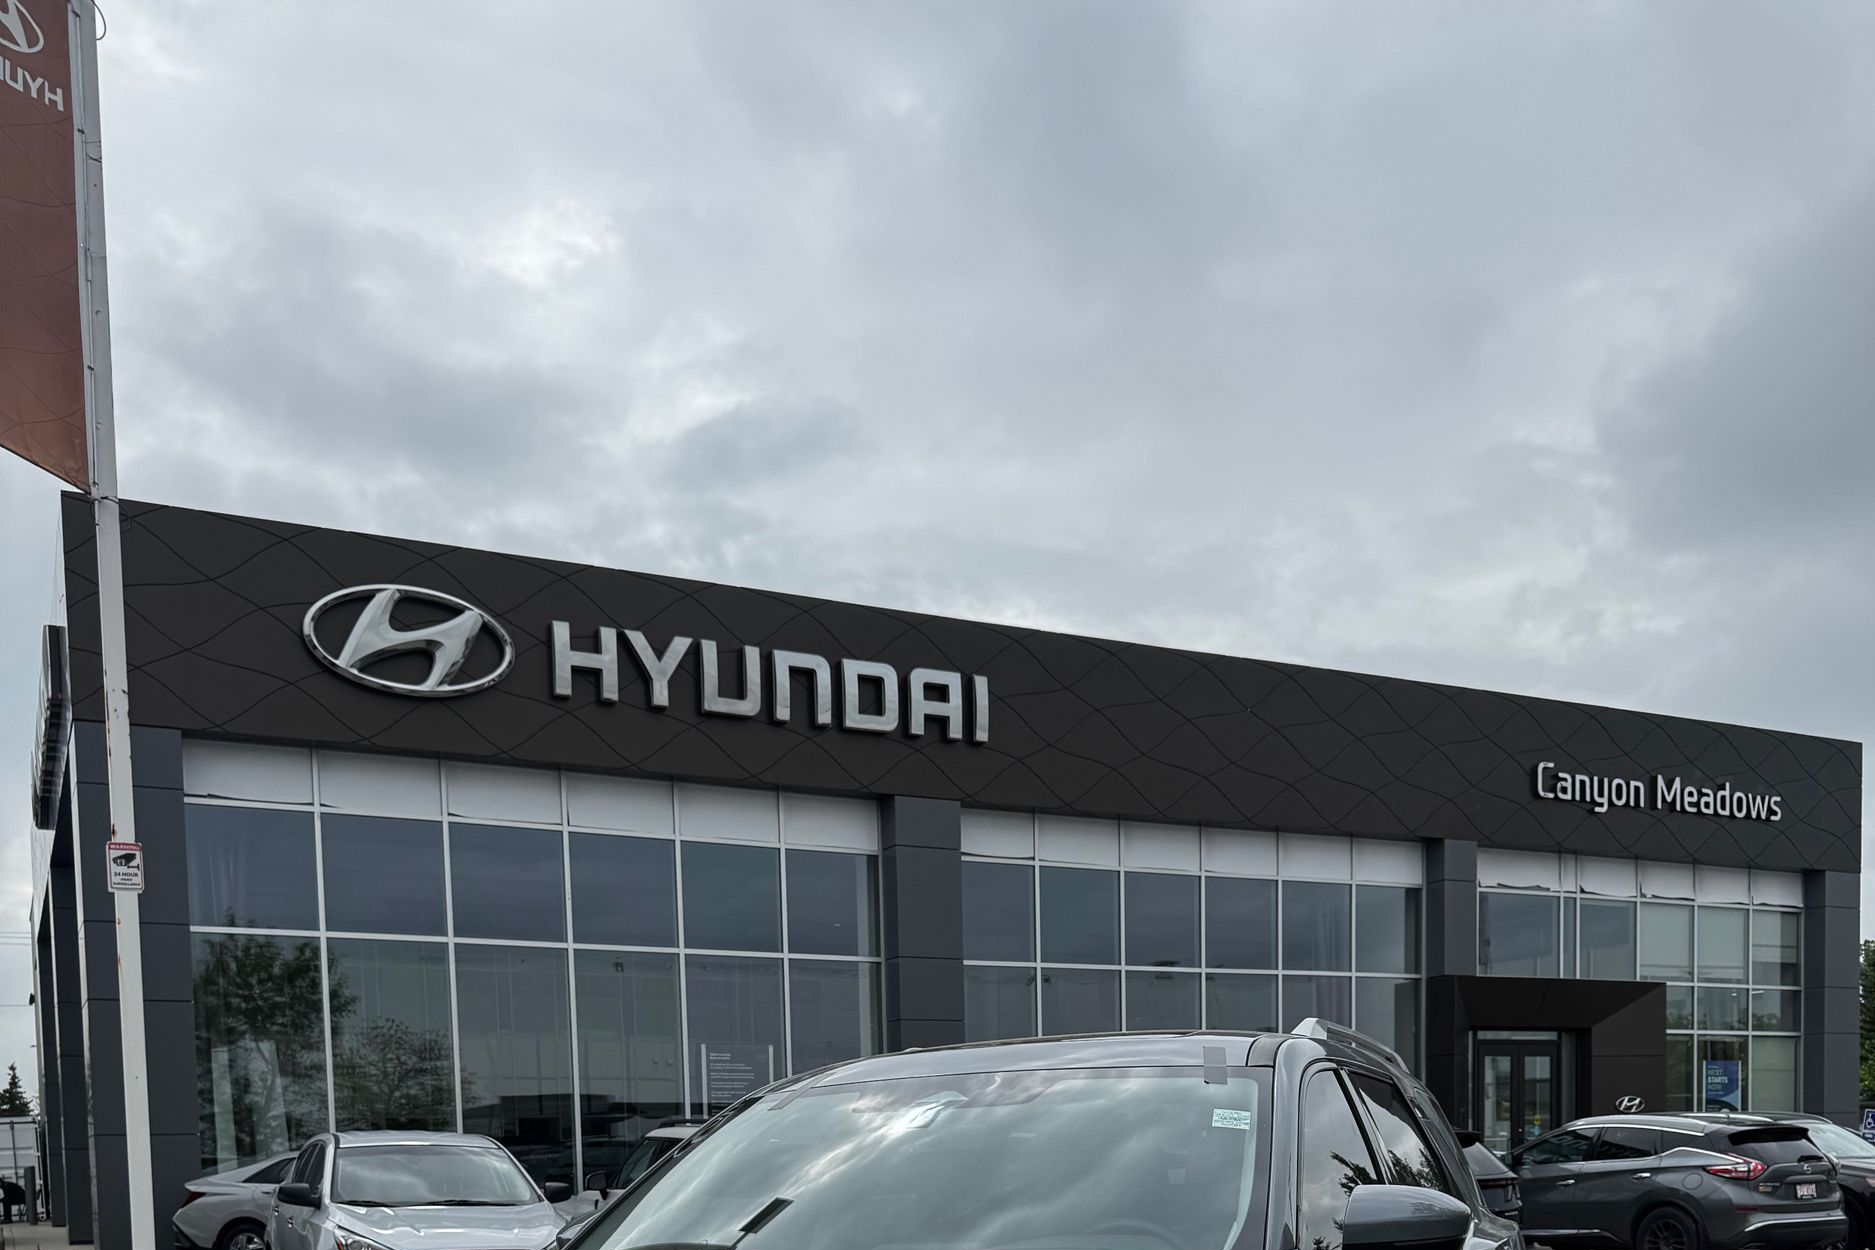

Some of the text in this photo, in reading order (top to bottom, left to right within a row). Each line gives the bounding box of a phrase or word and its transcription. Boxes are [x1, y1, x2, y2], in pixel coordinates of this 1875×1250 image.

[551, 620, 989, 744] HYUNDAI
[1537, 761, 1782, 822] Canyon Meadows
